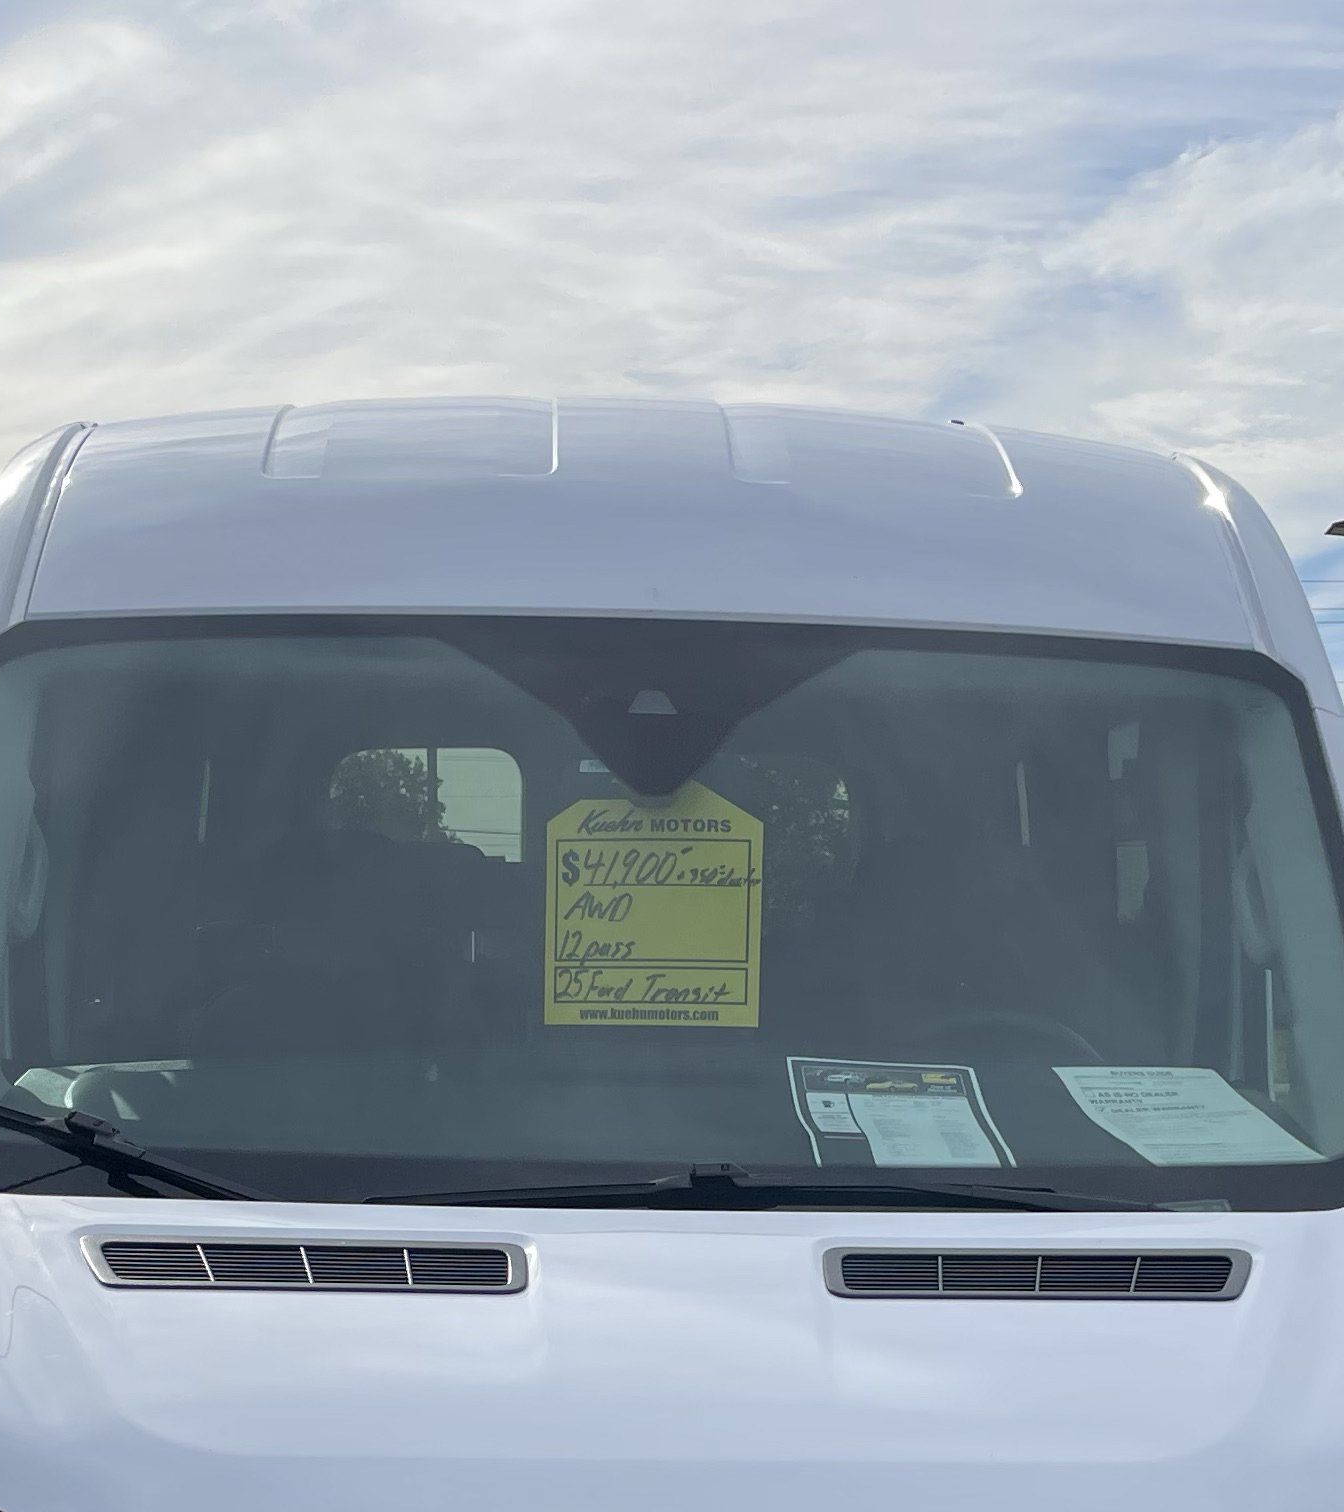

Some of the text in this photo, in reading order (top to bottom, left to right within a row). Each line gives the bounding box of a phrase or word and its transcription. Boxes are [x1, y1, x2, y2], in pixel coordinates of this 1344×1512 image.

[577, 809, 732, 835] Kuehn MOTORS
[563, 890, 634, 922] AWD
[559, 929, 583, 961] 12
[556, 967, 585, 1000] 25
[584, 969, 634, 1001] Ford
[579, 1007, 720, 1022] www.kuehnmotors.com
